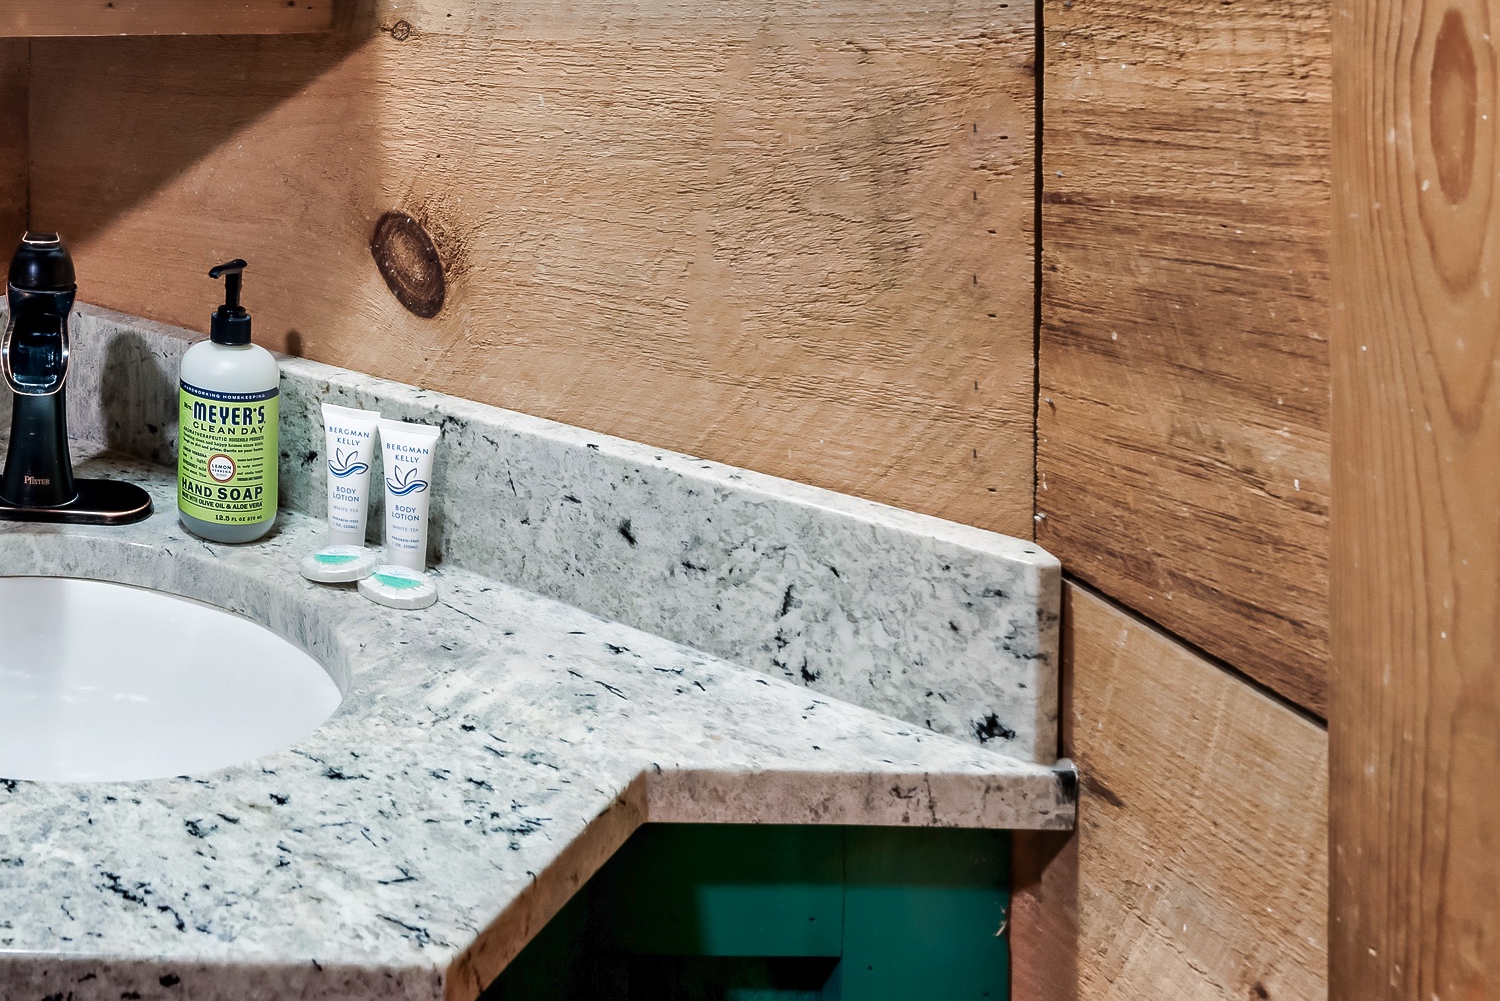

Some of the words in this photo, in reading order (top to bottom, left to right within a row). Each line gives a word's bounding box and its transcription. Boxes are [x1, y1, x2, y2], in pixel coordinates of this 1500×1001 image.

[193, 401, 265, 425] MEYER'S
[193, 421, 235, 435] CLEAN
[241, 426, 264, 435] DAY
[329, 426, 370, 438] BERGMAN
[337, 437, 360, 446] KELLY
[387, 442, 429, 455] BERGMAN
[395, 454, 419, 464] KELLY
[182, 477, 212, 497] HAND
[218, 486, 263, 500] SOAP
[336, 486, 356, 494] BODY
[333, 493, 359, 502] LOTION
[199, 499, 214, 507] OLIVE
[396, 505, 416, 513] BODY
[392, 512, 420, 521] LOTION
